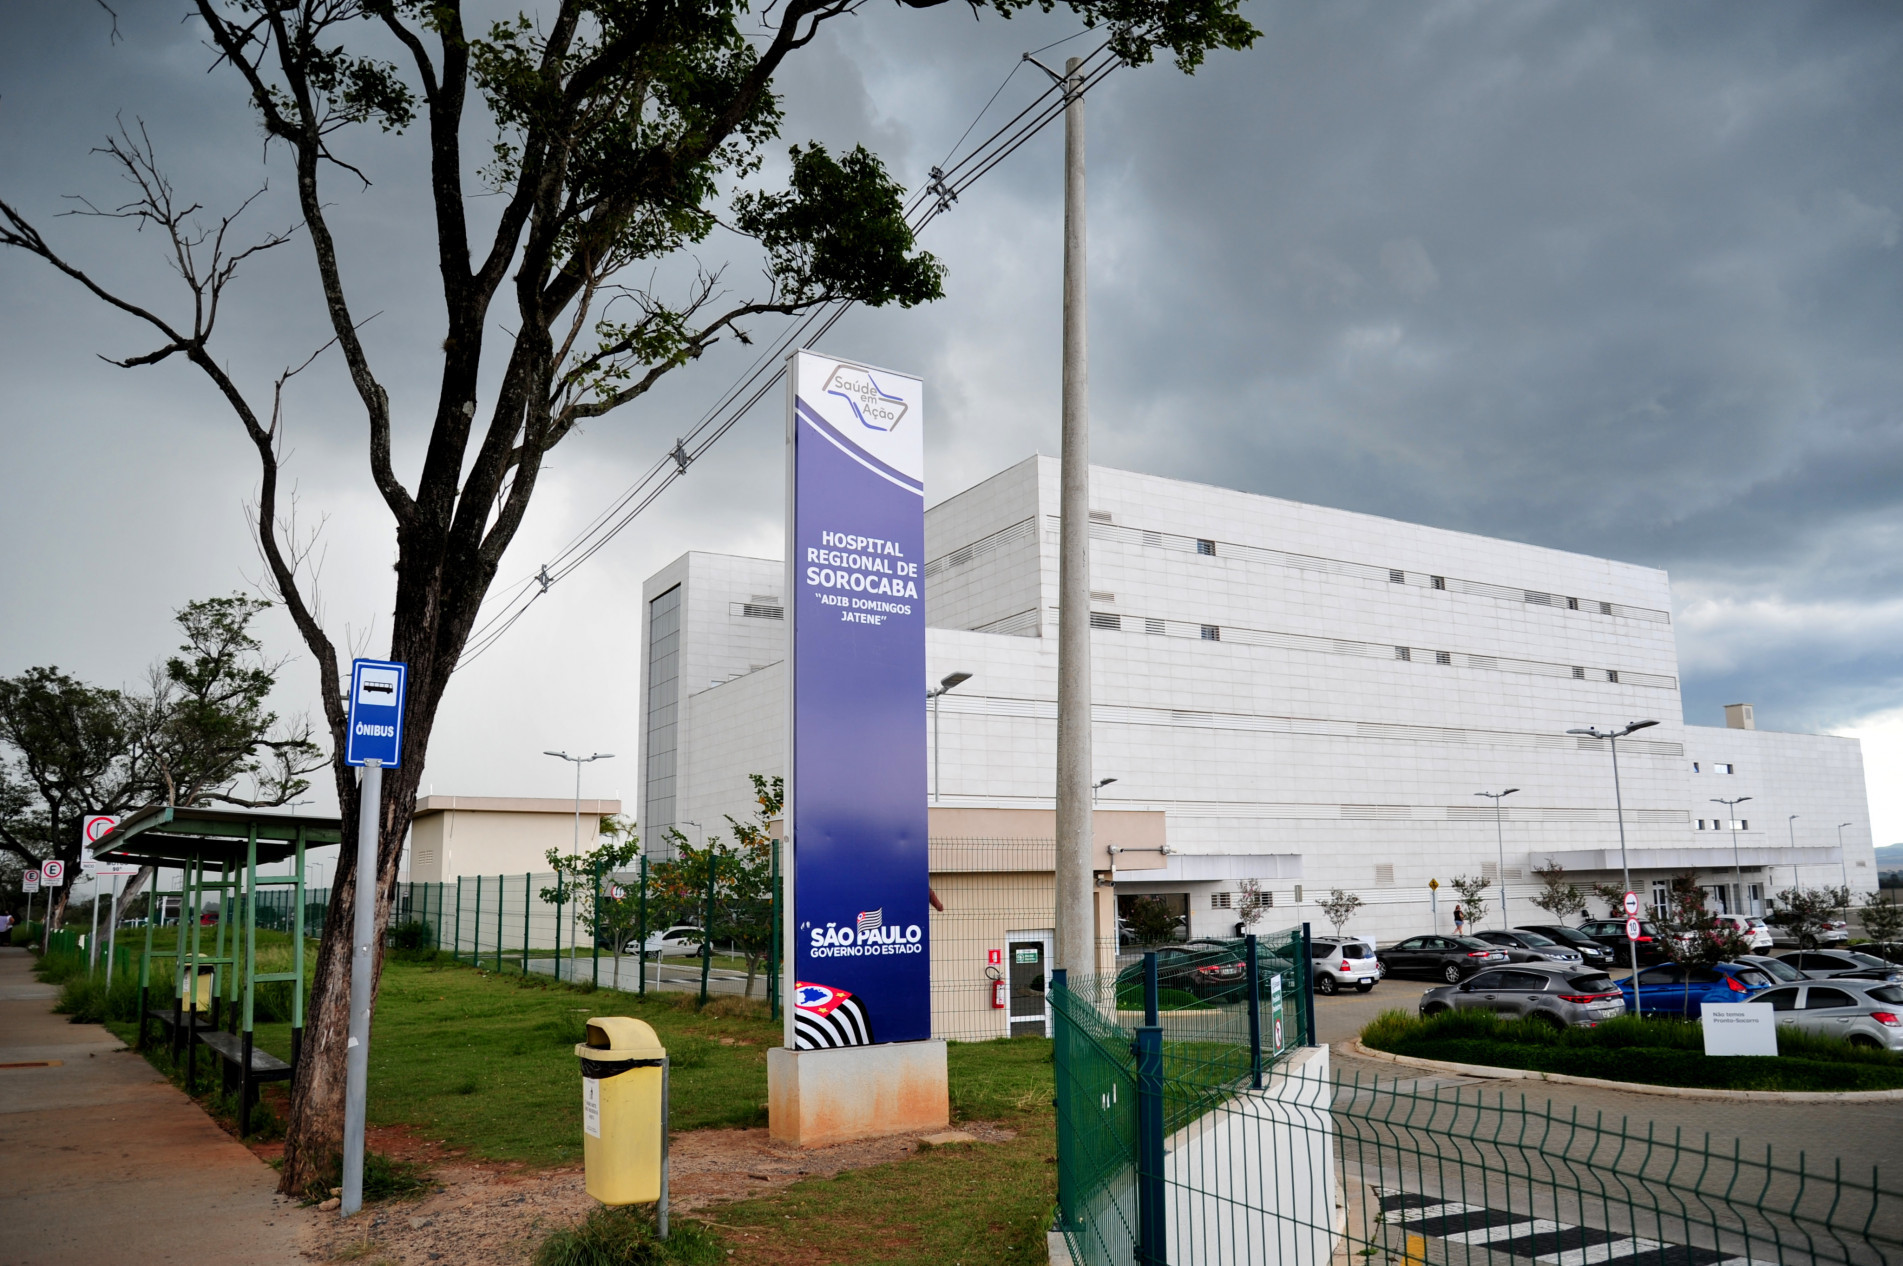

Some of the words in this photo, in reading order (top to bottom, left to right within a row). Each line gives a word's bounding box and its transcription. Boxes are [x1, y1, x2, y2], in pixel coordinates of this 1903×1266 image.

[835, 375, 878, 397] Saúde
[860, 394, 878, 405] em
[862, 403, 895, 420] Ação
[822, 530, 904, 557] HOSPITAL
[807, 547, 893, 574] REGIONAL
[897, 561, 918, 578] DE
[806, 566, 918, 599] SOROCABA
[852, 598, 911, 615] DOMINGOS
[355, 721, 395, 738] ÔNIBUS
[29, 872, 35, 880] E
[49, 865, 57, 875] E
[810, 922, 855, 947] SÃO
[857, 924, 922, 945] PAULO
[1629, 922, 1637, 932] 10
[810, 945, 863, 958] GOVERNO
[864, 945, 881, 956] DO
[882, 943, 922, 955] ESTADO
